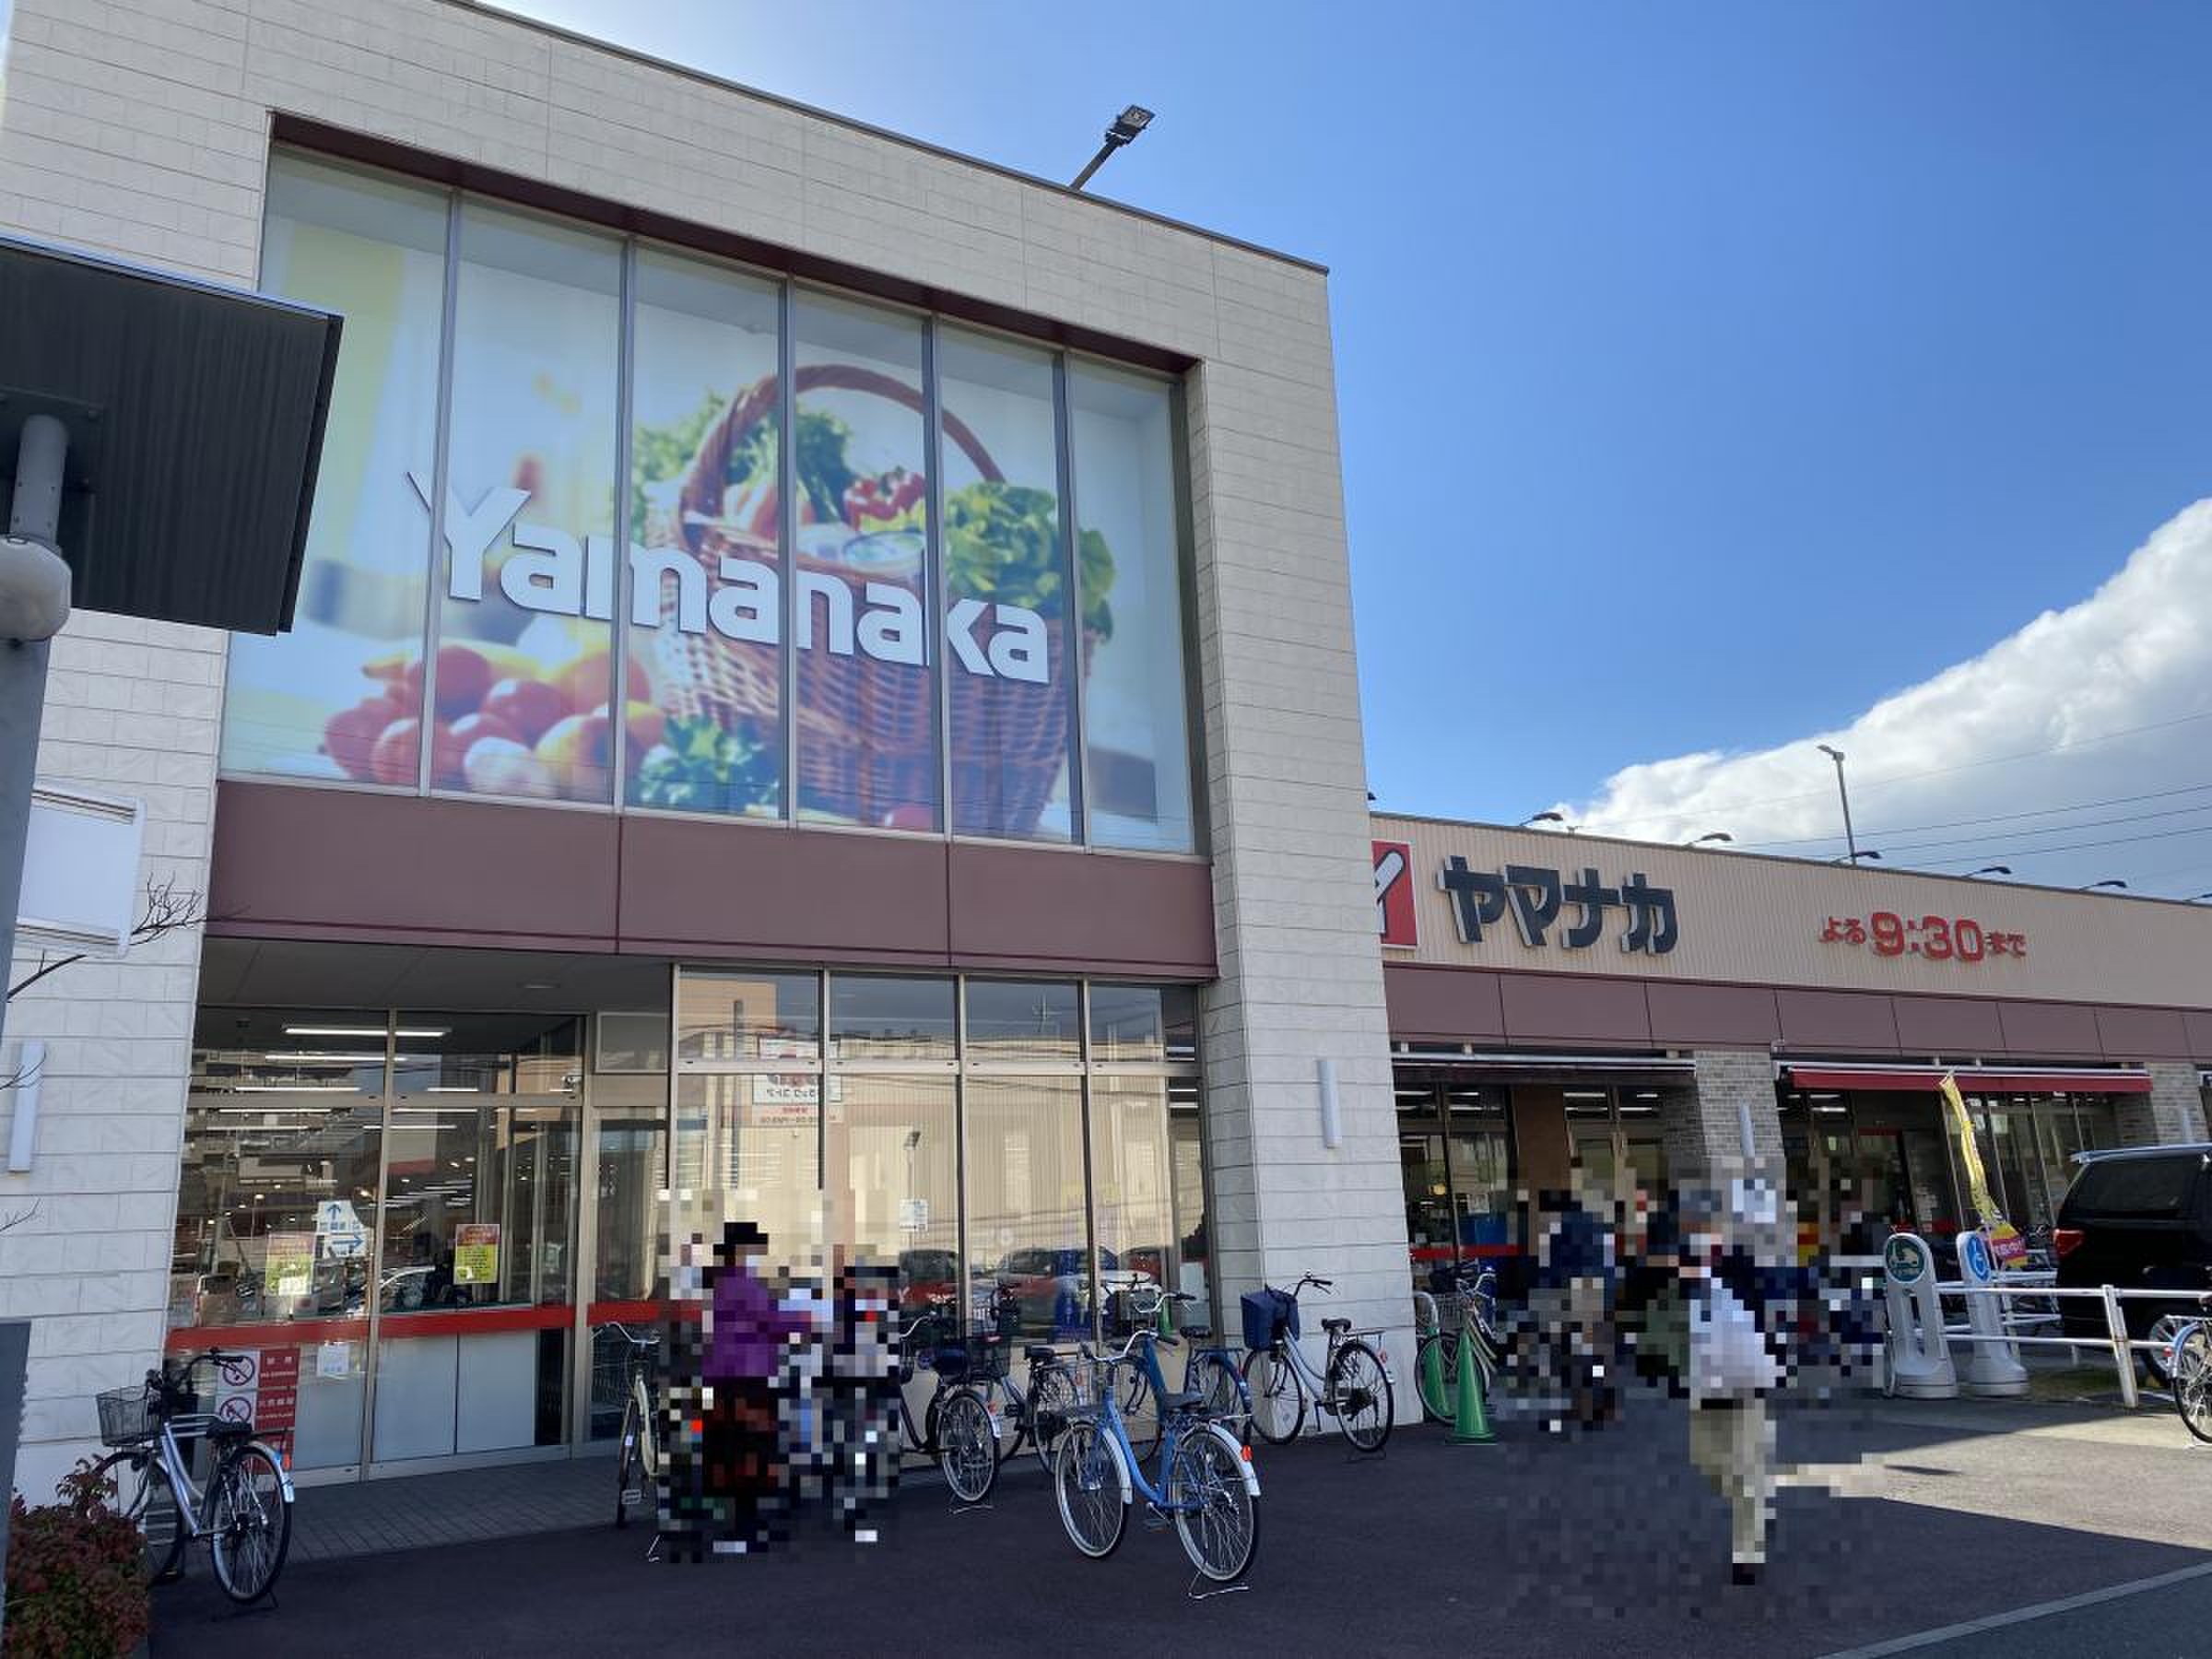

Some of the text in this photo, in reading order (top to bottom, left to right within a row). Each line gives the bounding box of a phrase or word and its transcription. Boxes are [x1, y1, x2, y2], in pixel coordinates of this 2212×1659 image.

[406, 471, 1050, 684] Yamanaka
[1437, 855, 1679, 955] ヤマナカ
[1818, 912, 2027, 961] よる9:30まで
